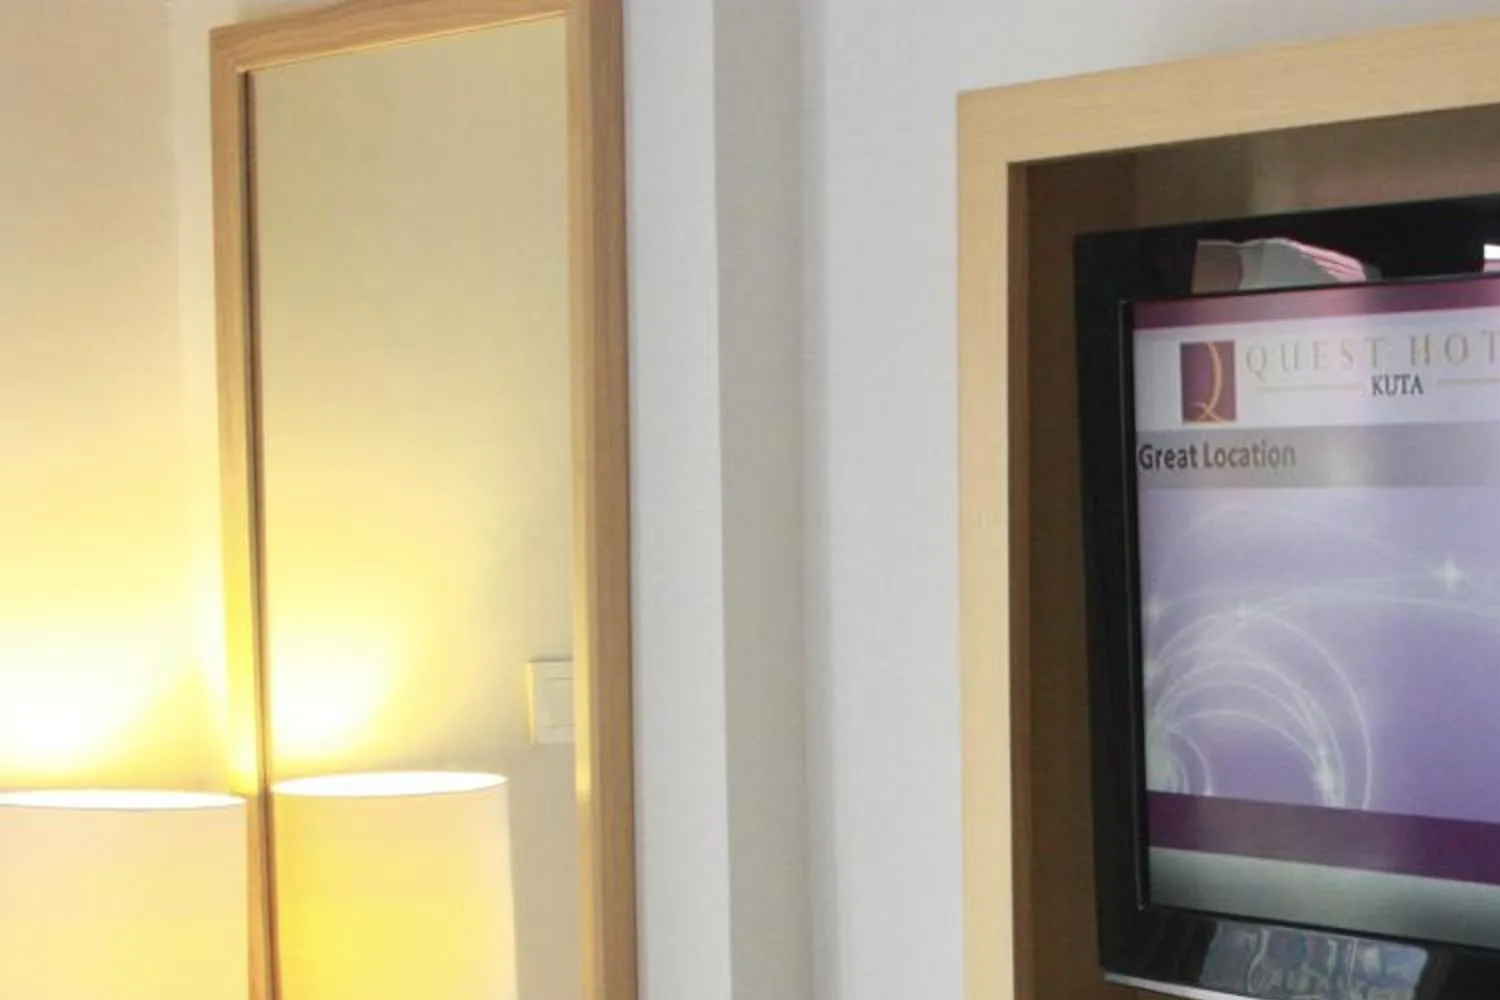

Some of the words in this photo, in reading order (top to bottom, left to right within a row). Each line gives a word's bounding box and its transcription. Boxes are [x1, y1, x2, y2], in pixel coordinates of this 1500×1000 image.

[1244, 335, 1385, 378] QUEST
[1370, 374, 1424, 397] KUTA
[1137, 443, 1198, 471] Great
[1203, 440, 1297, 470] Location
